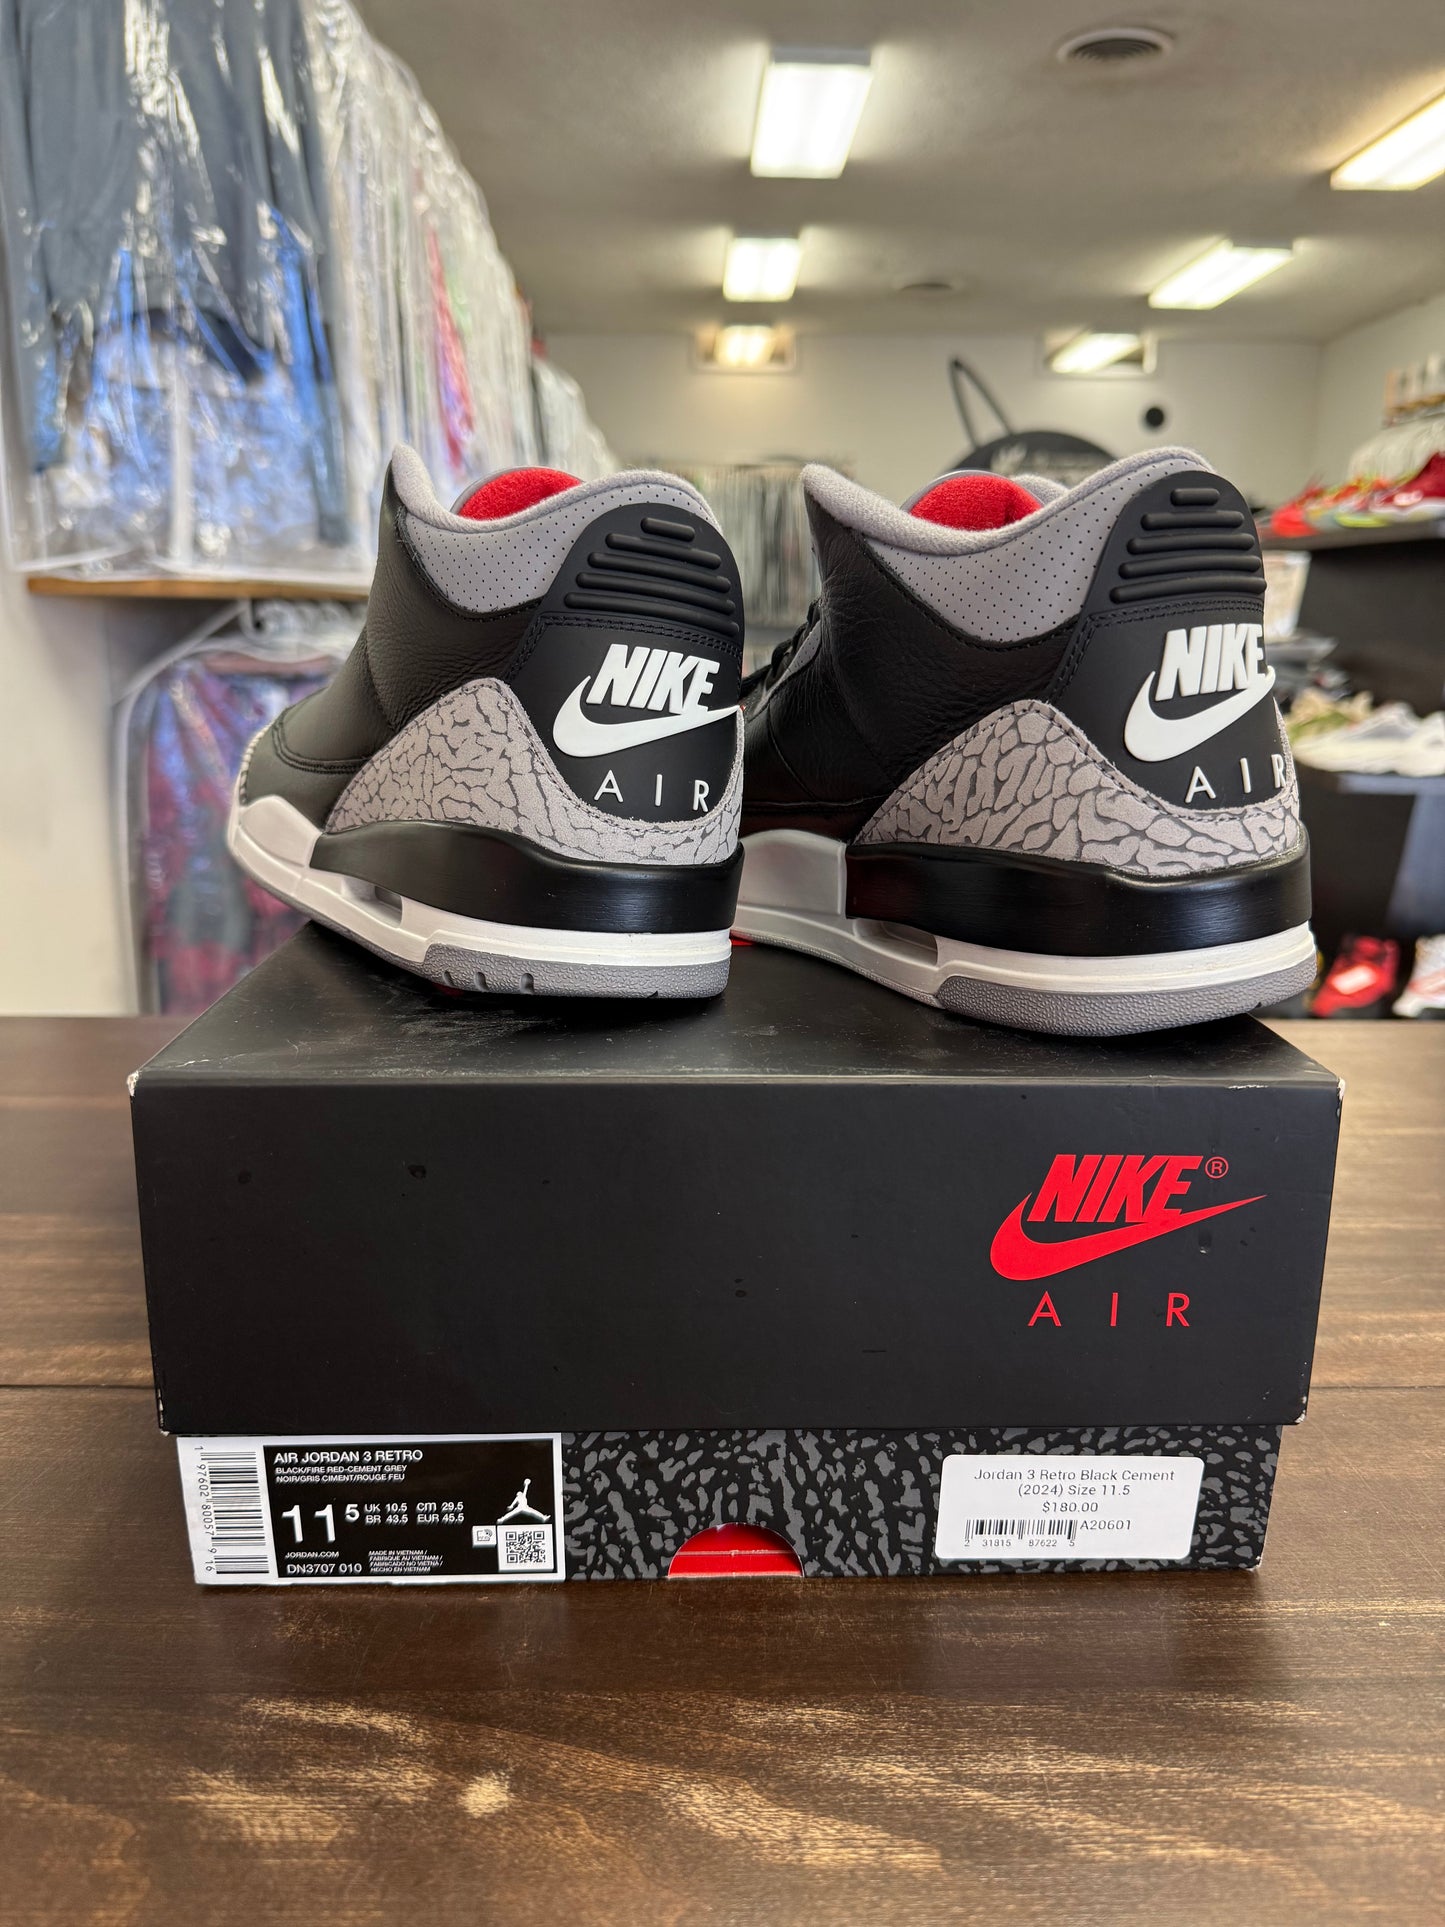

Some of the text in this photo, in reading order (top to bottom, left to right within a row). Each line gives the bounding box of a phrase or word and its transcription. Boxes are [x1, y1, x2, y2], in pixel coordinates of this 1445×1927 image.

[1155, 623, 1266, 702] NIKE
[586, 643, 721, 716] NIKE
[1185, 753, 1287, 804] AIR
[593, 769, 710, 813] AIR
[1027, 1154, 1203, 1222] NIKE
[1027, 1291, 1190, 1327] AIR
[274, 1449, 423, 1463] AIR JORDAN 3 RETRO
[197, 1464, 210, 1497] 97602
[974, 1469, 1175, 1481] Jordan 3 Retro Black Cement
[1018, 1484, 1131, 1497] (2024) Size 11.5
[364, 1504, 380, 1512] UK
[365, 1515, 381, 1523] BR
[417, 1514, 439, 1522] EUR
[1042, 1501, 1099, 1513] $180.00
[201, 1504, 215, 1536] 80057
[281, 1504, 336, 1543] 11
[1079, 1519, 1131, 1530] A20601
[964, 1539, 1075, 1547] 2 31815 87622 5
[286, 1563, 362, 1573] DN3707 010
